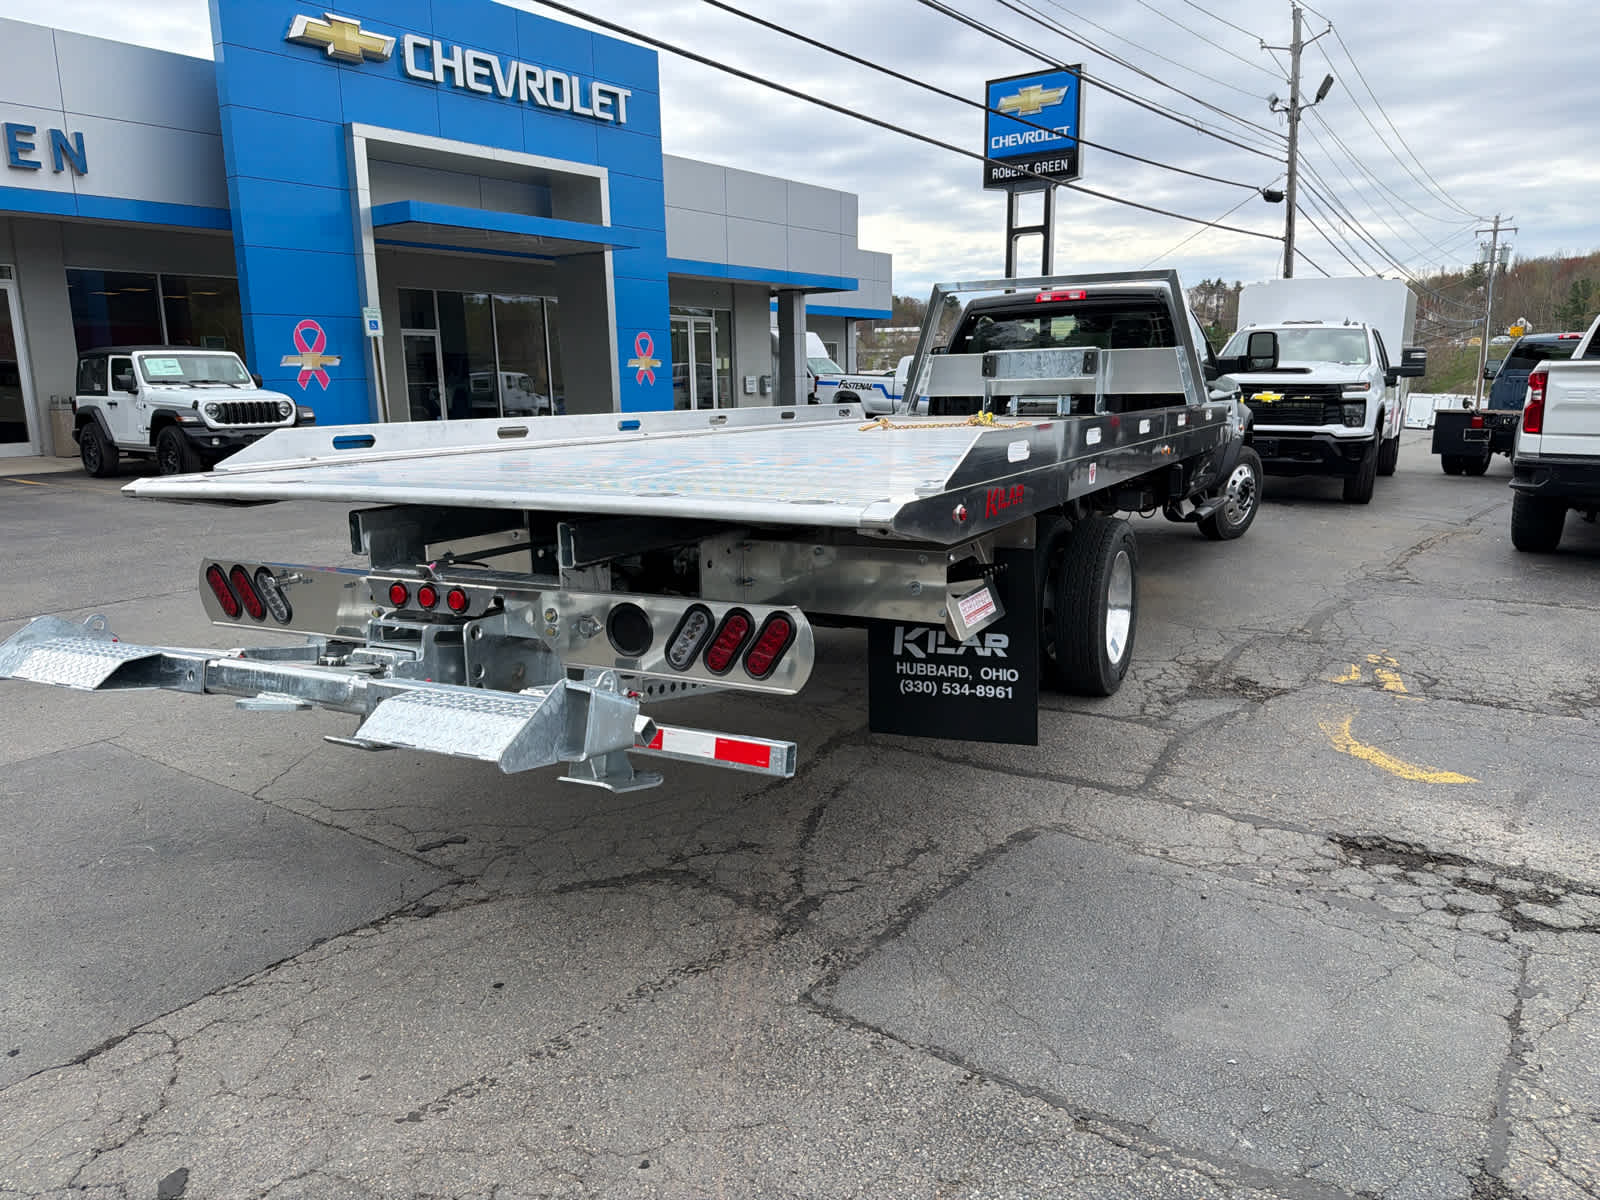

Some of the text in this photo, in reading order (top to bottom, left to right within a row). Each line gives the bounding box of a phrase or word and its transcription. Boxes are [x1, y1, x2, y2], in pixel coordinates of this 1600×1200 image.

[403, 33, 632, 124] CHEVROLET
[991, 125, 1071, 149] CHEVROLET
[992, 159, 1068, 180] ROBERT GREEN
[985, 484, 1025, 519] KILAR
[893, 626, 1009, 659] KILAR
[896, 661, 1019, 682] HUBBARD, OHIO
[900, 679, 1013, 699] (330) 534-8961
